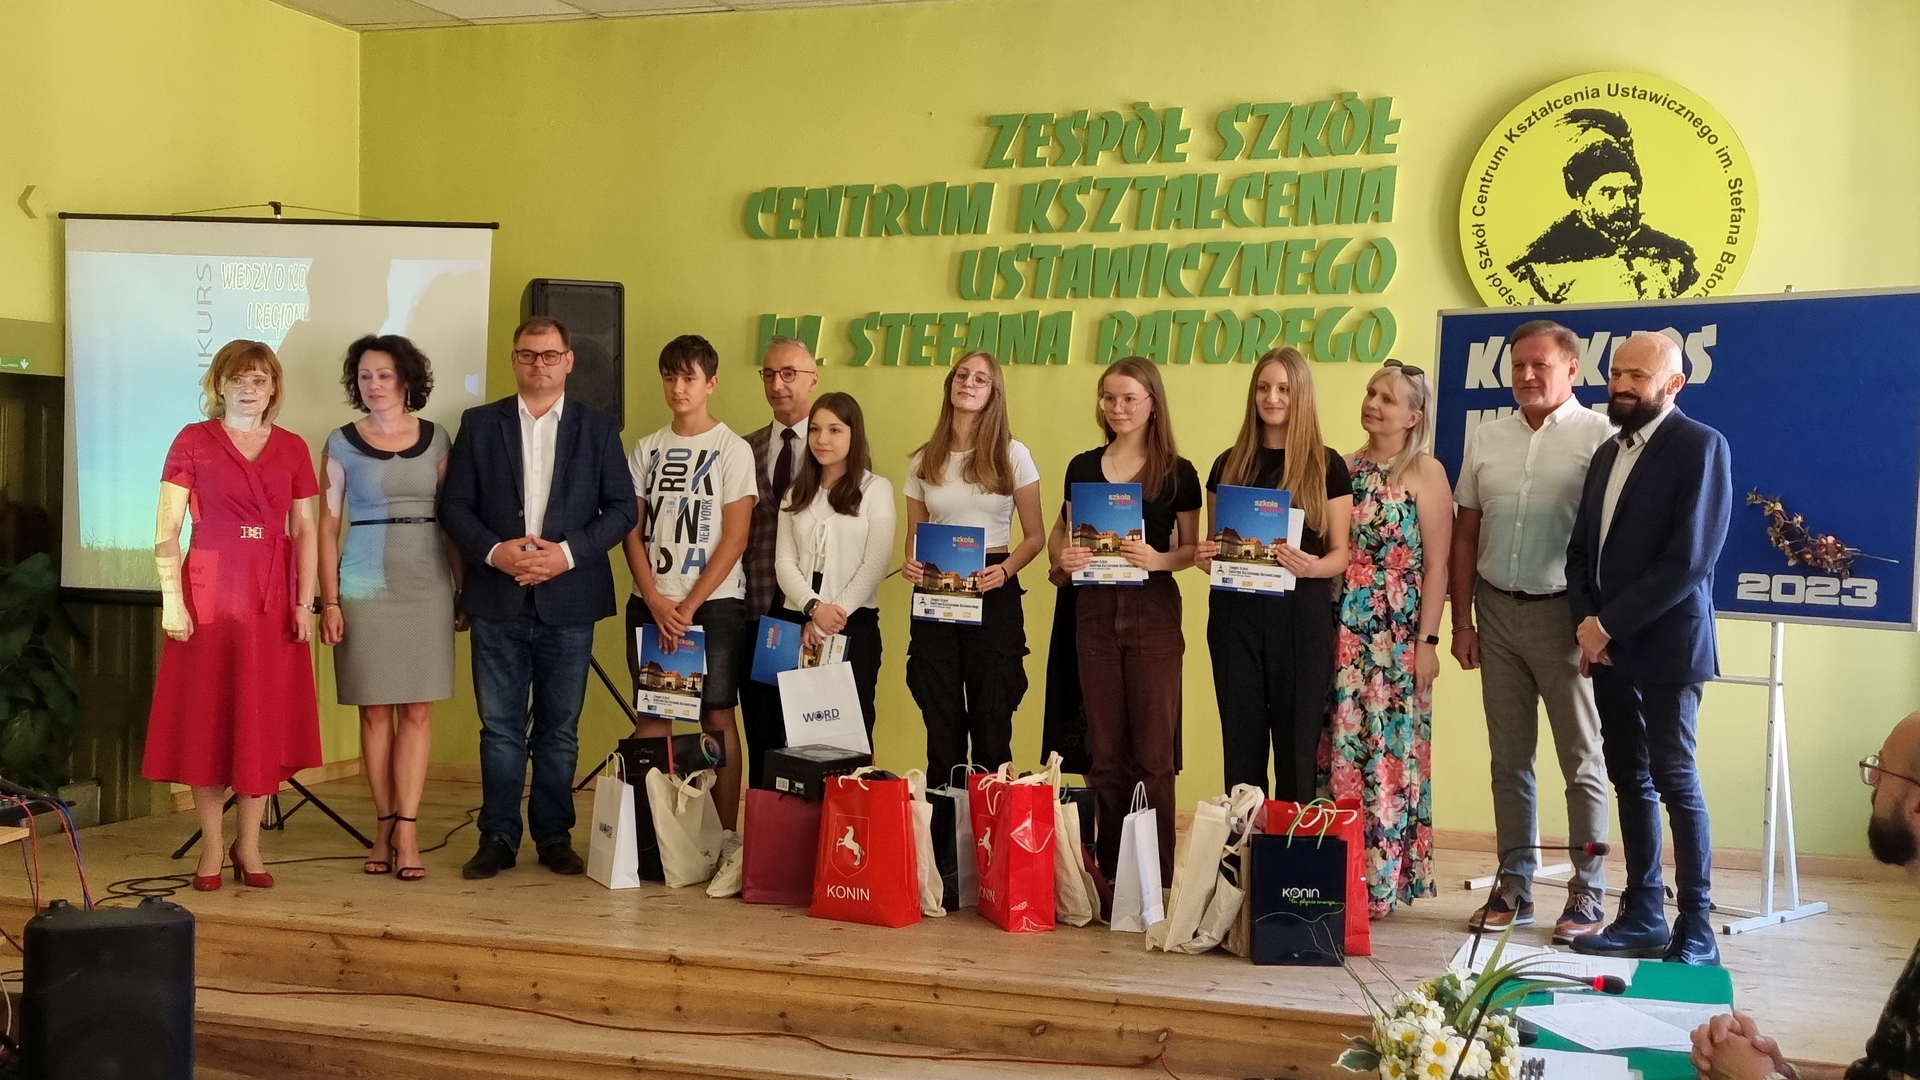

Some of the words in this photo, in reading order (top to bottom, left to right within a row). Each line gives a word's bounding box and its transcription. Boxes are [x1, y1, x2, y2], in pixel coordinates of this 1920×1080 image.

[1504, 86, 1600, 144] Kształcenia
[1608, 83, 1718, 144] Ustawicznego
[1472, 146, 1508, 216] Centrum
[1716, 146, 1732, 174] im.
[743, 181, 996, 239] CENTRUM
[1016, 166, 1399, 234] KSZTAŁCENIA
[1726, 178, 1745, 244] Stefana
[959, 238, 1398, 300] USTAWICZNEGO
[1472, 224, 1492, 269] Szkół
[221, 262, 272, 291] WIEDZY
[274, 263, 286, 291] O
[850, 310, 1075, 366] STEFANA
[1096, 306, 1398, 365] BATOREGO
[699, 524, 711, 543] NEW
[700, 498, 713, 521] YORK
[1737, 573, 1878, 607] 2023
[802, 708, 840, 722] WORD
[827, 884, 870, 901] KONIN
